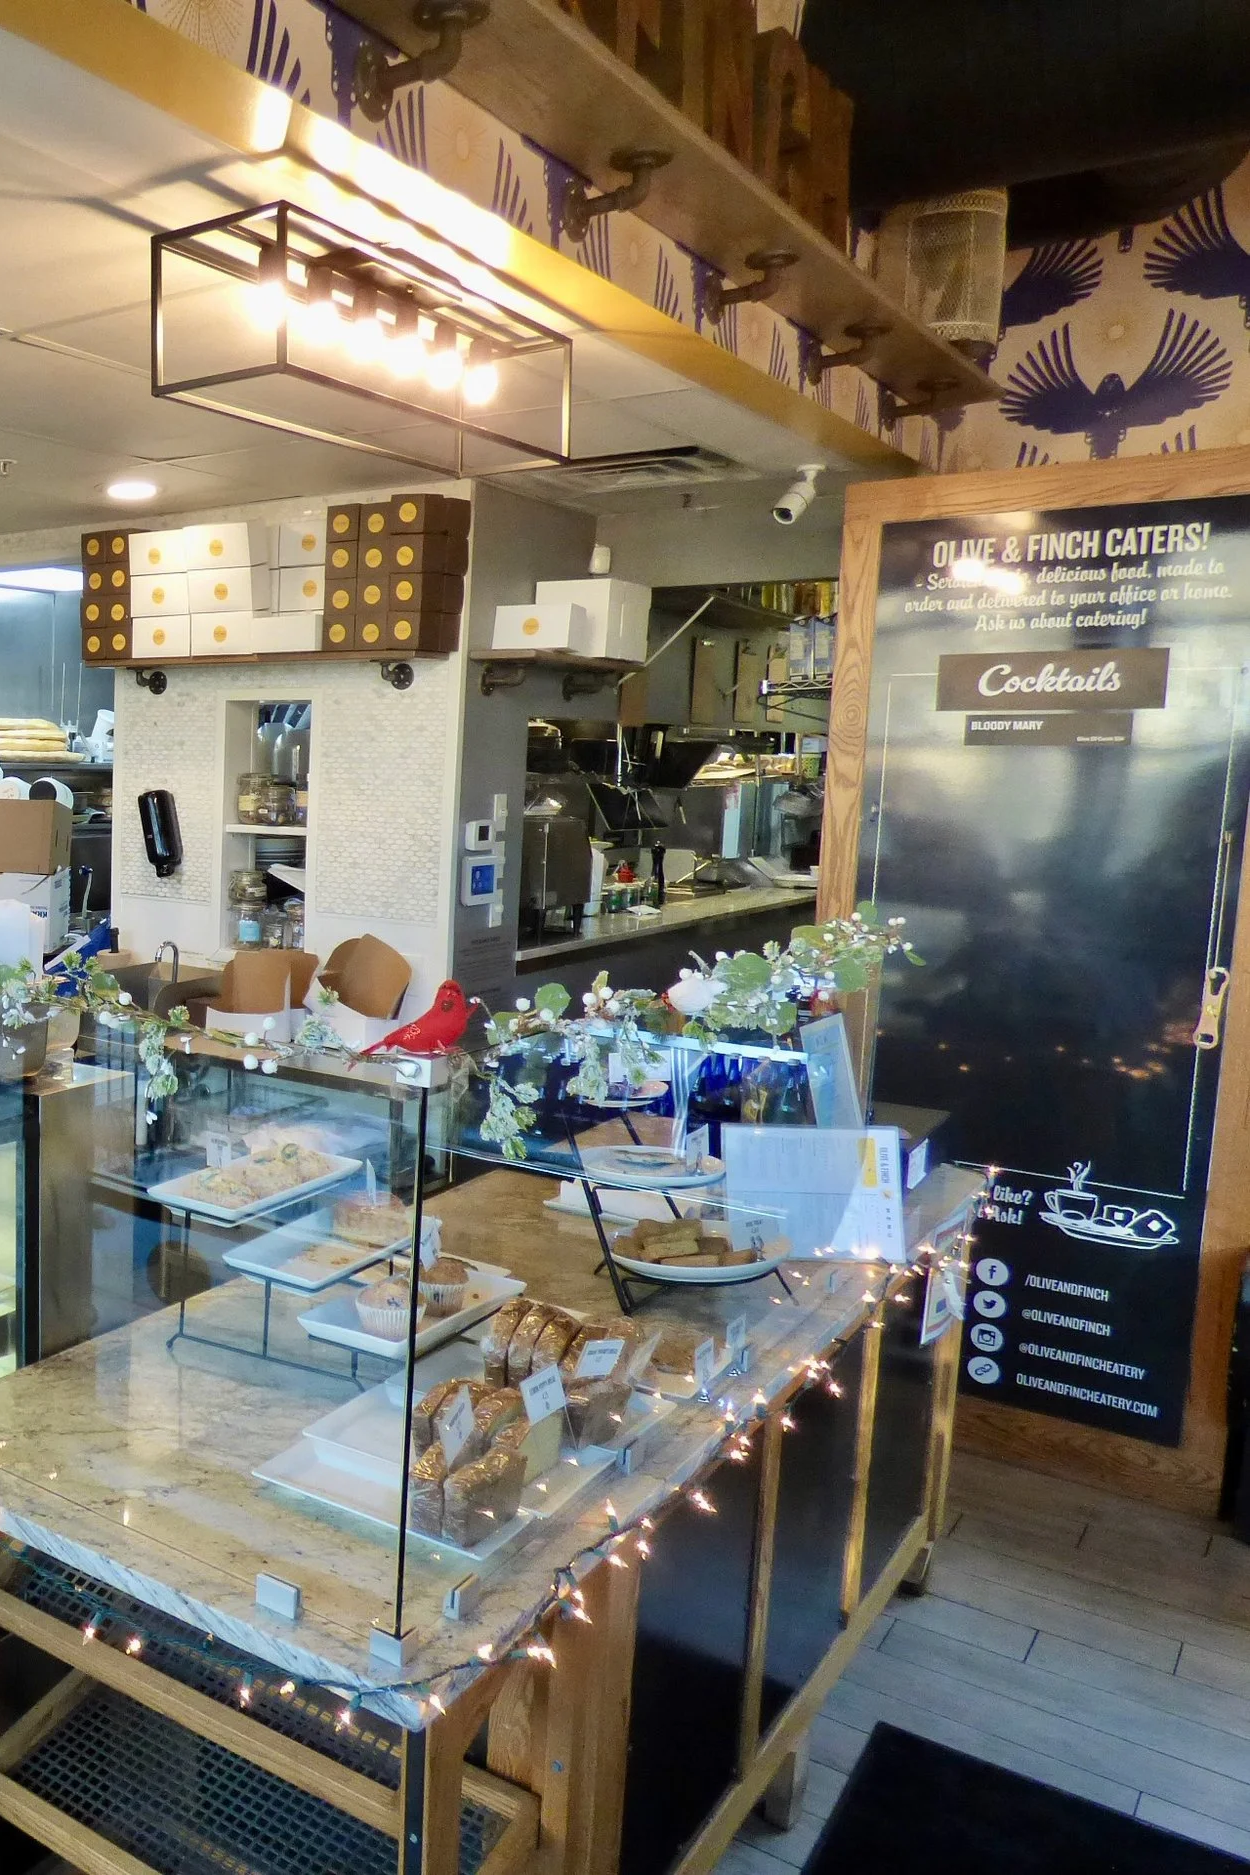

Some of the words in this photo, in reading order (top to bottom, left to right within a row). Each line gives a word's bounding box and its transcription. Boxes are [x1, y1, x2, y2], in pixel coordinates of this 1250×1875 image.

[932, 537, 997, 568] OLIVE
[1001, 536, 1022, 563] &
[1027, 529, 1101, 561] FINCH
[1105, 521, 1212, 558] CATERS!
[1036, 563, 1107, 585] delicious
[1157, 558, 1204, 578] made
[1208, 557, 1226, 575] to
[904, 596, 944, 613] order
[946, 593, 974, 611] and
[977, 589, 1047, 611] delivered
[1050, 589, 1066, 606] to
[1069, 590, 1107, 609] your
[1109, 584, 1158, 605] office
[1160, 588, 1180, 602] or
[974, 613, 1005, 632] Ask
[1009, 617, 1026, 630] us
[1029, 612, 1073, 630] about
[1075, 608, 1149, 630] catering!
[978, 661, 1122, 697] Cocktails
[970, 720, 1012, 731] BLOODY
[1012, 720, 1044, 731] MARY
[993, 1185, 1034, 1206] like?
[1024, 1274, 1110, 1302] /OLIVEANDFINCH
[1021, 1308, 1111, 1337] @OLIVEANDFINCH
[1018, 1342, 1146, 1380] @OLIVEANDFINCHEATERY
[1016, 1372, 1159, 1418] OLIVEANDFINCHEATERY.COM
